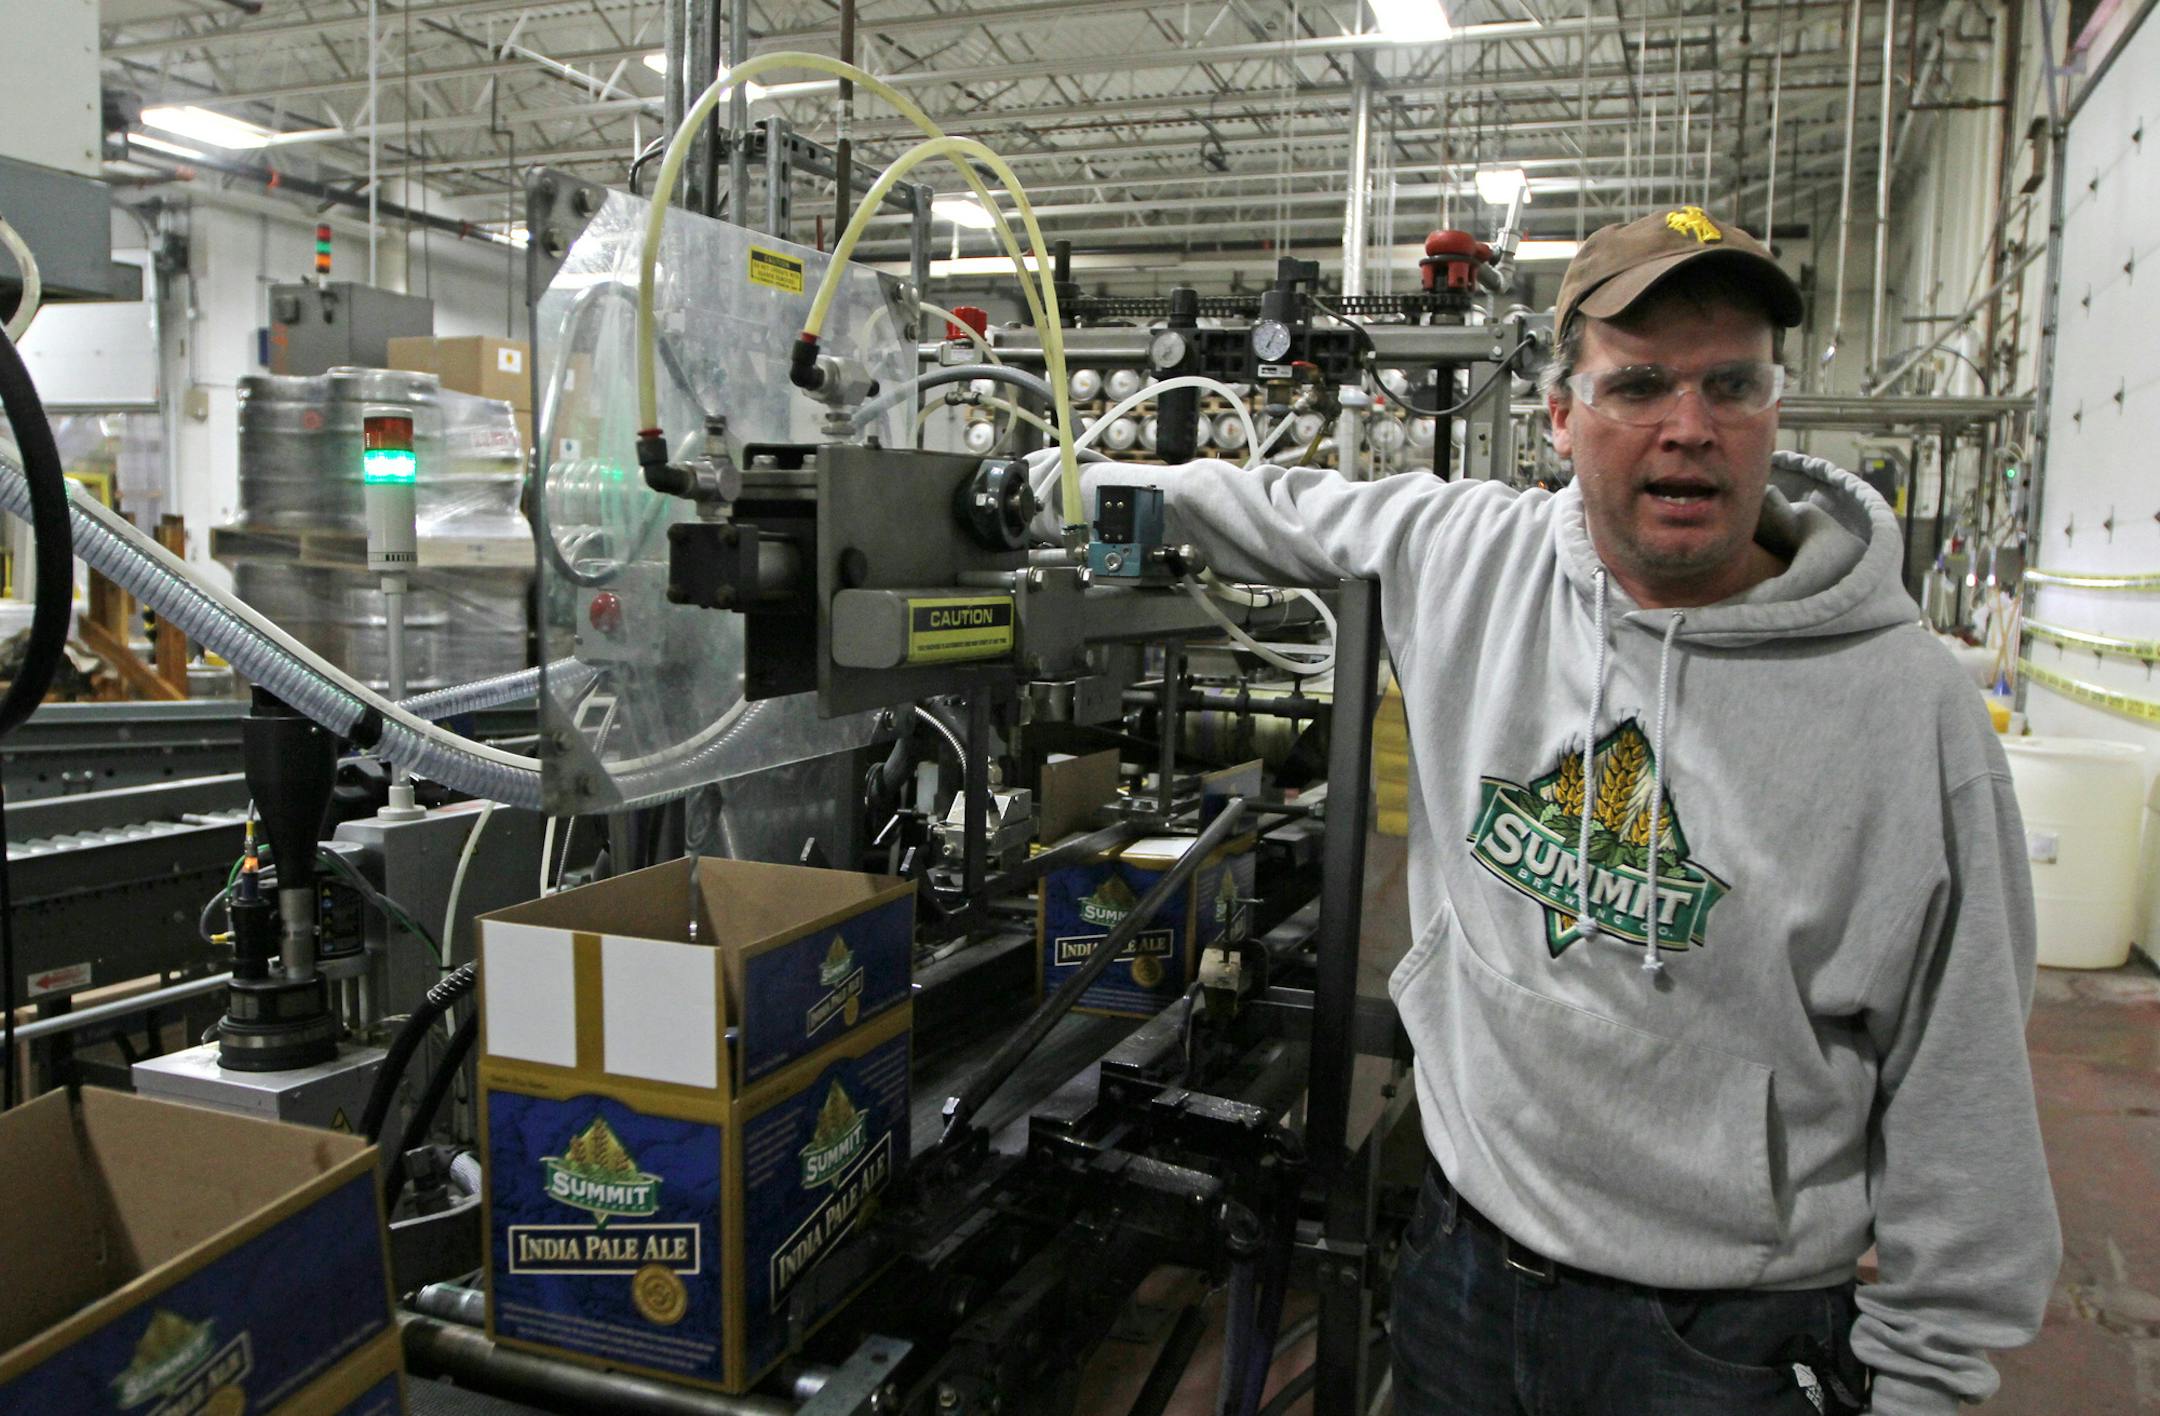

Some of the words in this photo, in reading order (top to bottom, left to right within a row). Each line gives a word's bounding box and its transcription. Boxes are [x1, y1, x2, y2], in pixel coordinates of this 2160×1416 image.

[930, 608, 993, 627] CAUTION
[1481, 812, 1693, 925] SUMMIT
[1084, 905, 1129, 921] SUMM
[1517, 867, 1623, 925] BREWNG
[1061, 942, 1099, 959] INDI
[807, 1124, 862, 1181] SUMMIT
[552, 1171, 650, 1205] SUMMIT
[779, 1222, 823, 1290] INDIA
[825, 1182, 859, 1239] PALE
[860, 1151, 886, 1199] ALE
[519, 1234, 580, 1262] INDIA
[585, 1236, 639, 1260] PALE
[642, 1234, 688, 1260] ALE
